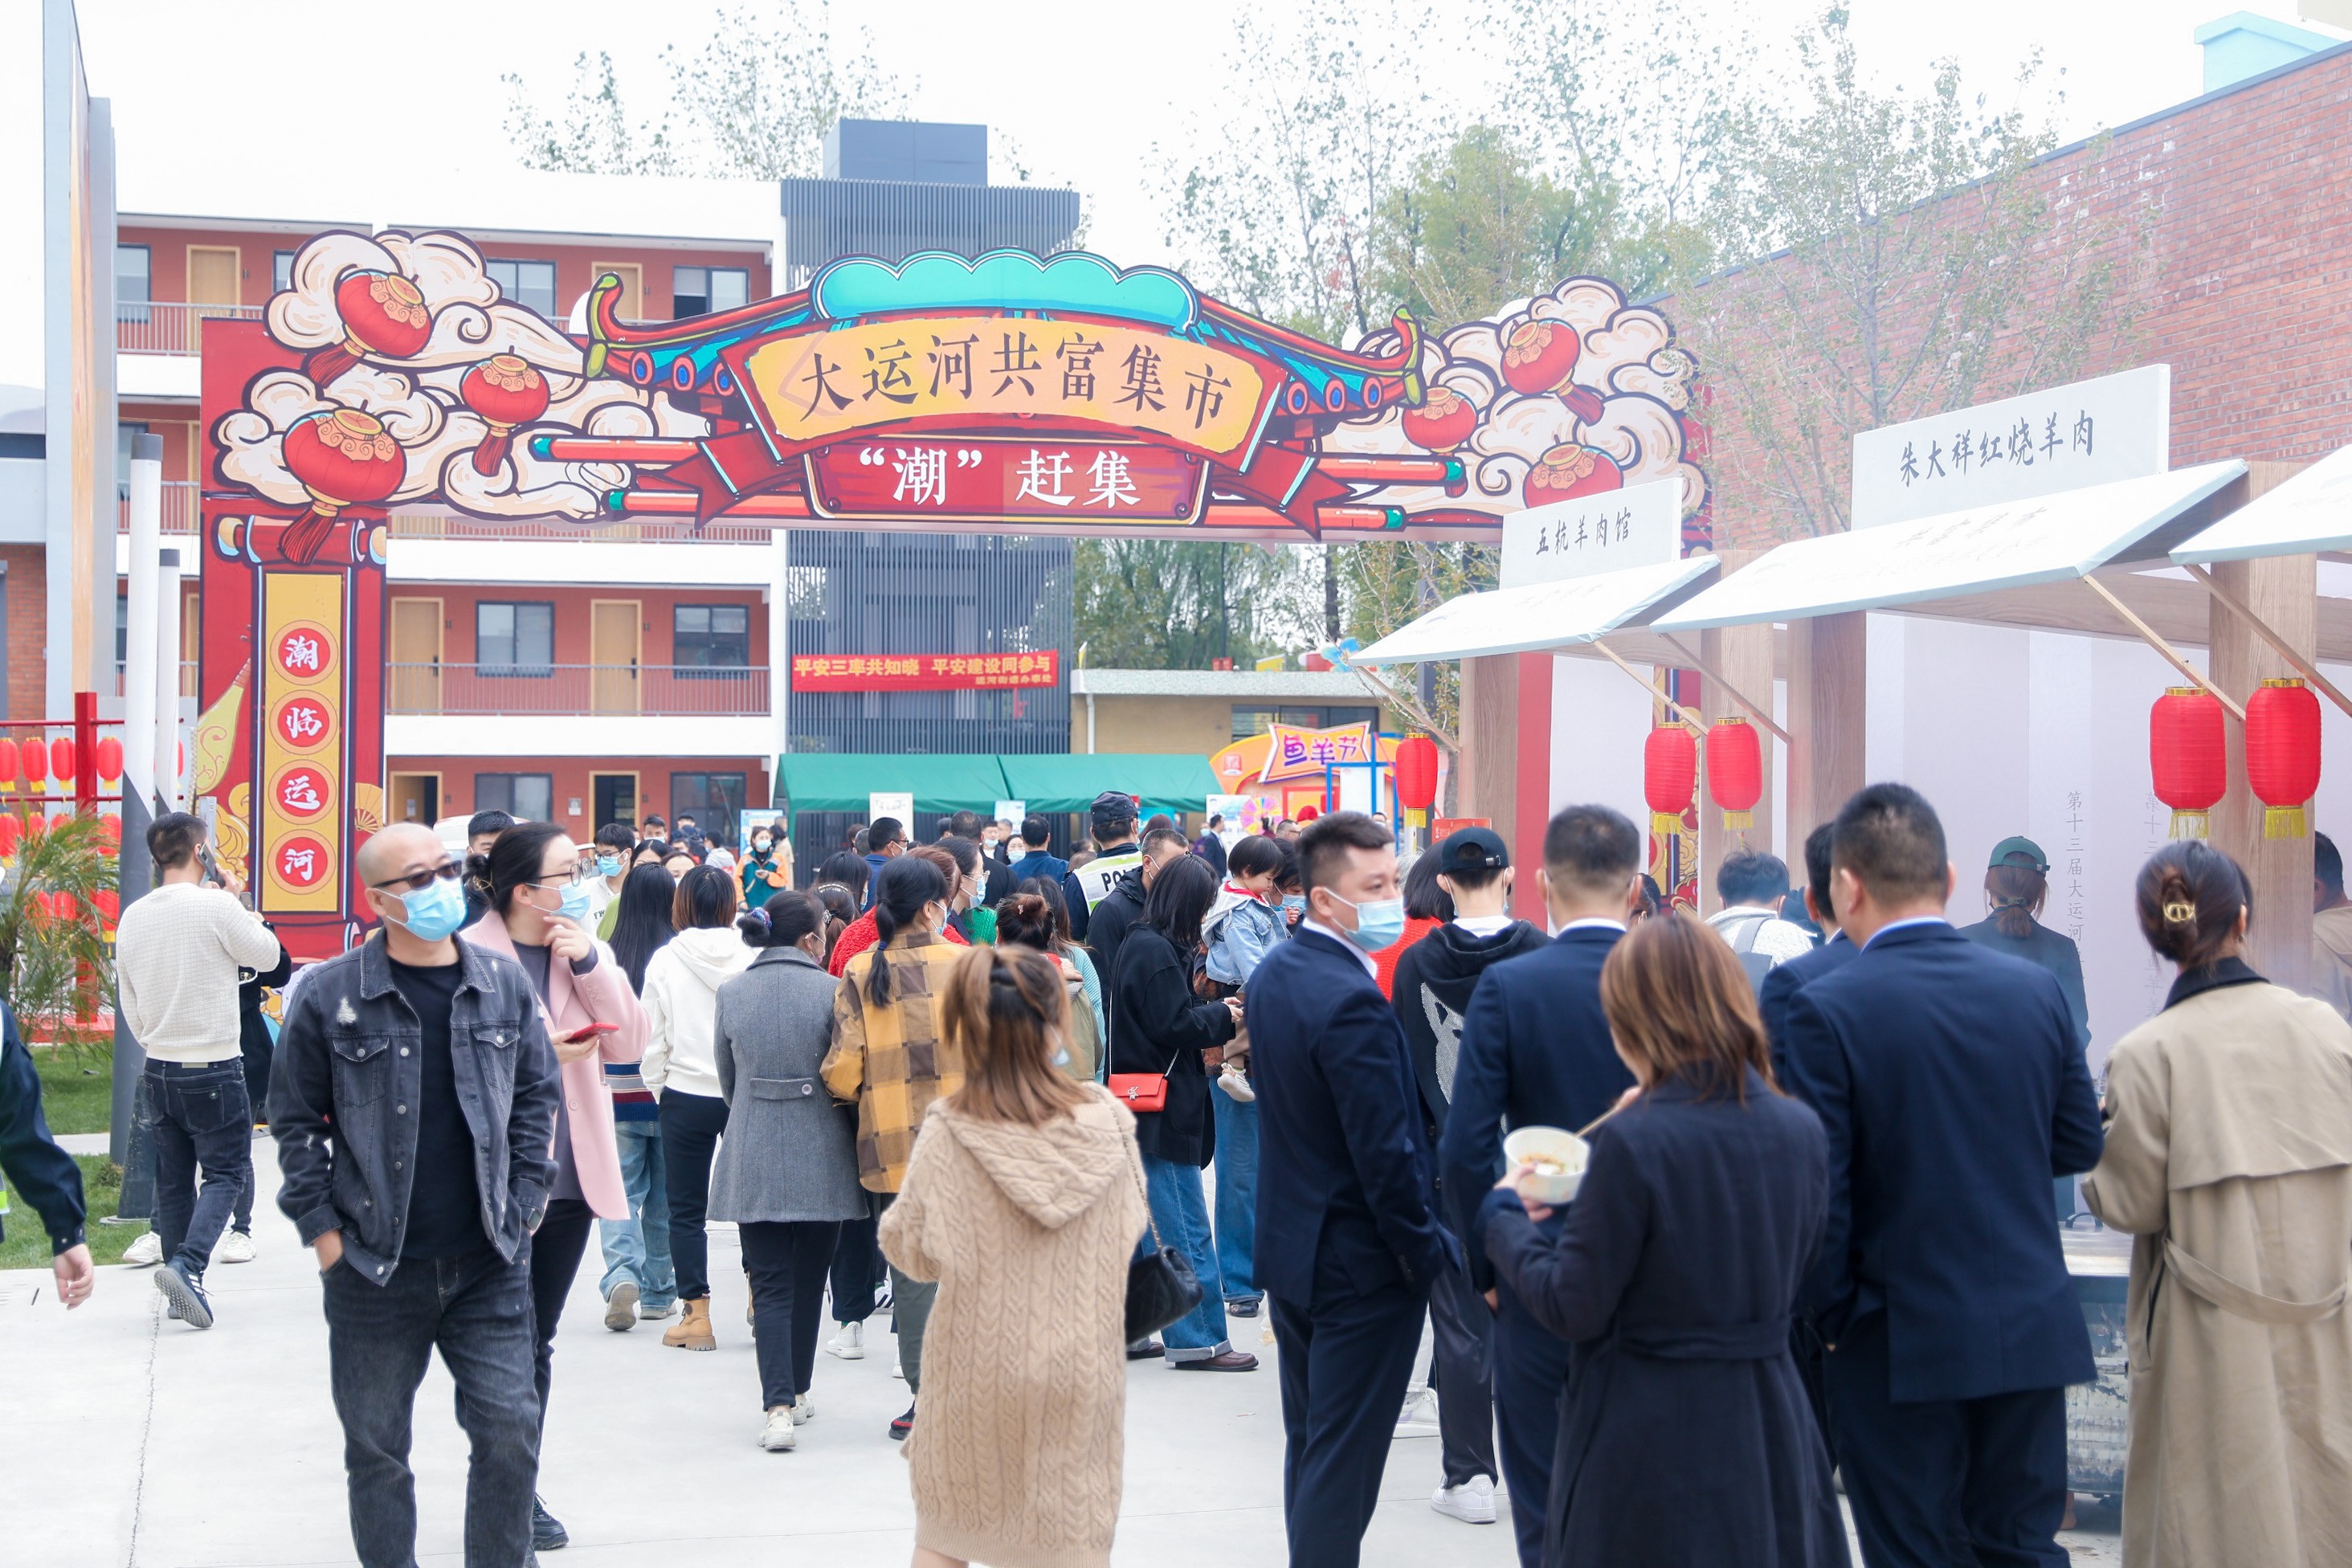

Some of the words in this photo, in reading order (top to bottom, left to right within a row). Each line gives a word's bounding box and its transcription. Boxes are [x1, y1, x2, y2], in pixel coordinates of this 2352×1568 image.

[800, 332, 1232, 430] 大运河共富集市
[1015, 448, 1141, 508] 赶集
[1899, 409, 2094, 488] 朱大祥红烧羊肉
[1535, 506, 1631, 556] 五杭羊肉馆
[794, 658, 920, 677] 平安三率共知晓
[931, 655, 1051, 676] 平安建设同参与
[284, 635, 323, 881] 潮临运河
[1283, 733, 1358, 767] 鱼羊节
[1100, 869, 1125, 892] PO
[2065, 790, 2085, 962] 第十三届大运河
